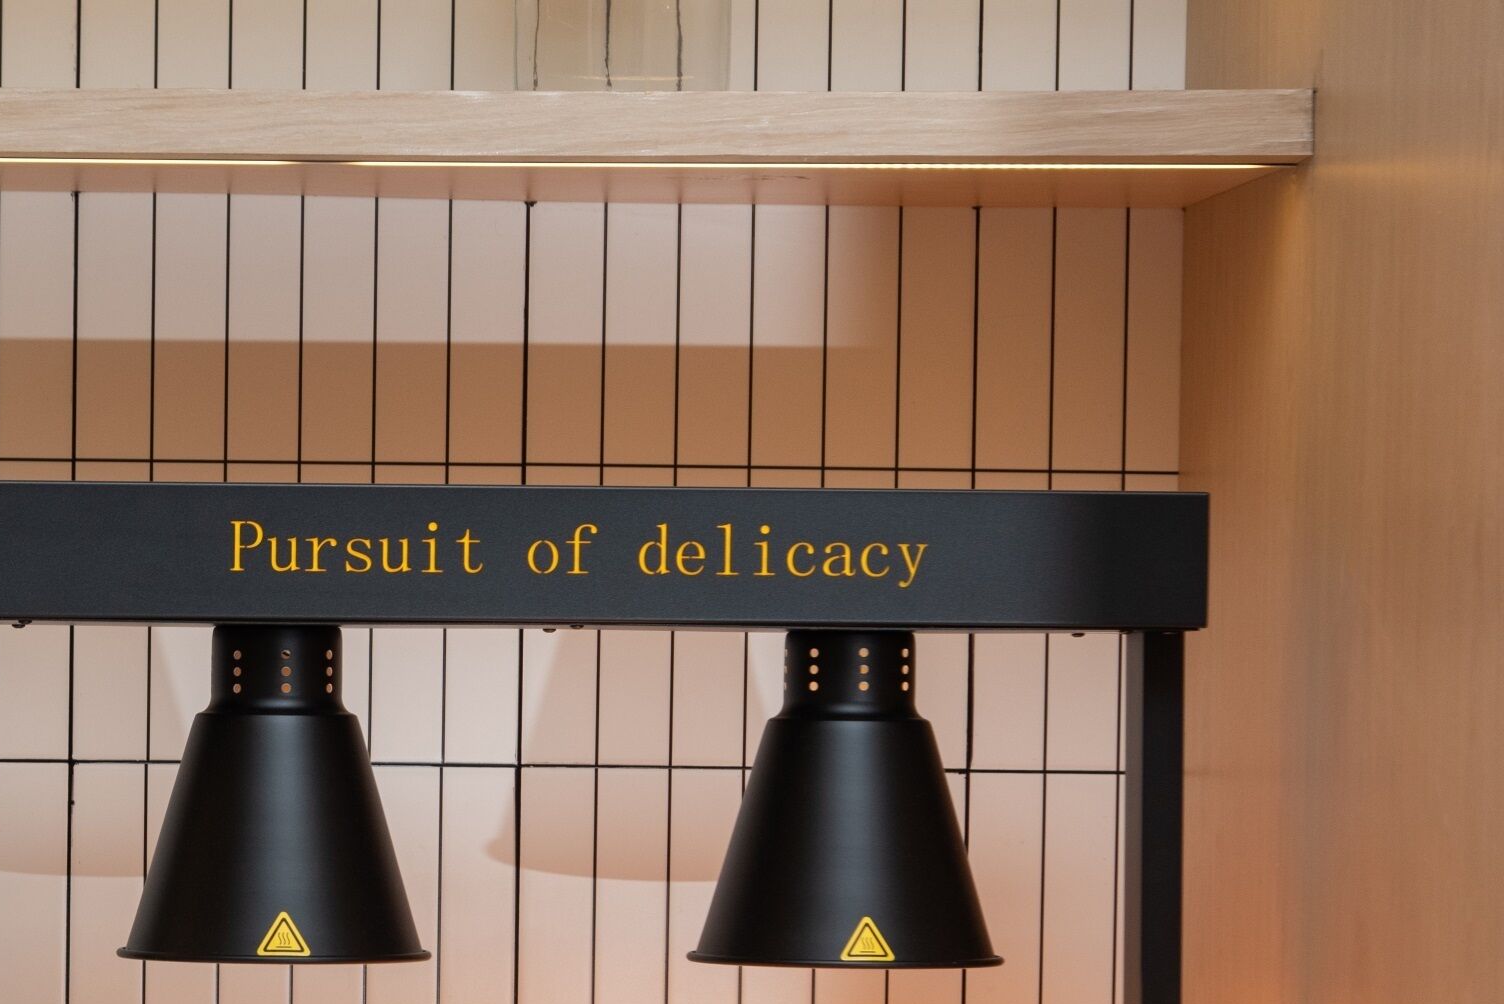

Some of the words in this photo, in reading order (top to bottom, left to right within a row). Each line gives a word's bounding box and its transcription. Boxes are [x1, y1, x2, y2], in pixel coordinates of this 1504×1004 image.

[229, 519, 484, 575] Pursuit
[526, 522, 599, 576] of
[638, 522, 929, 589] delicacy
